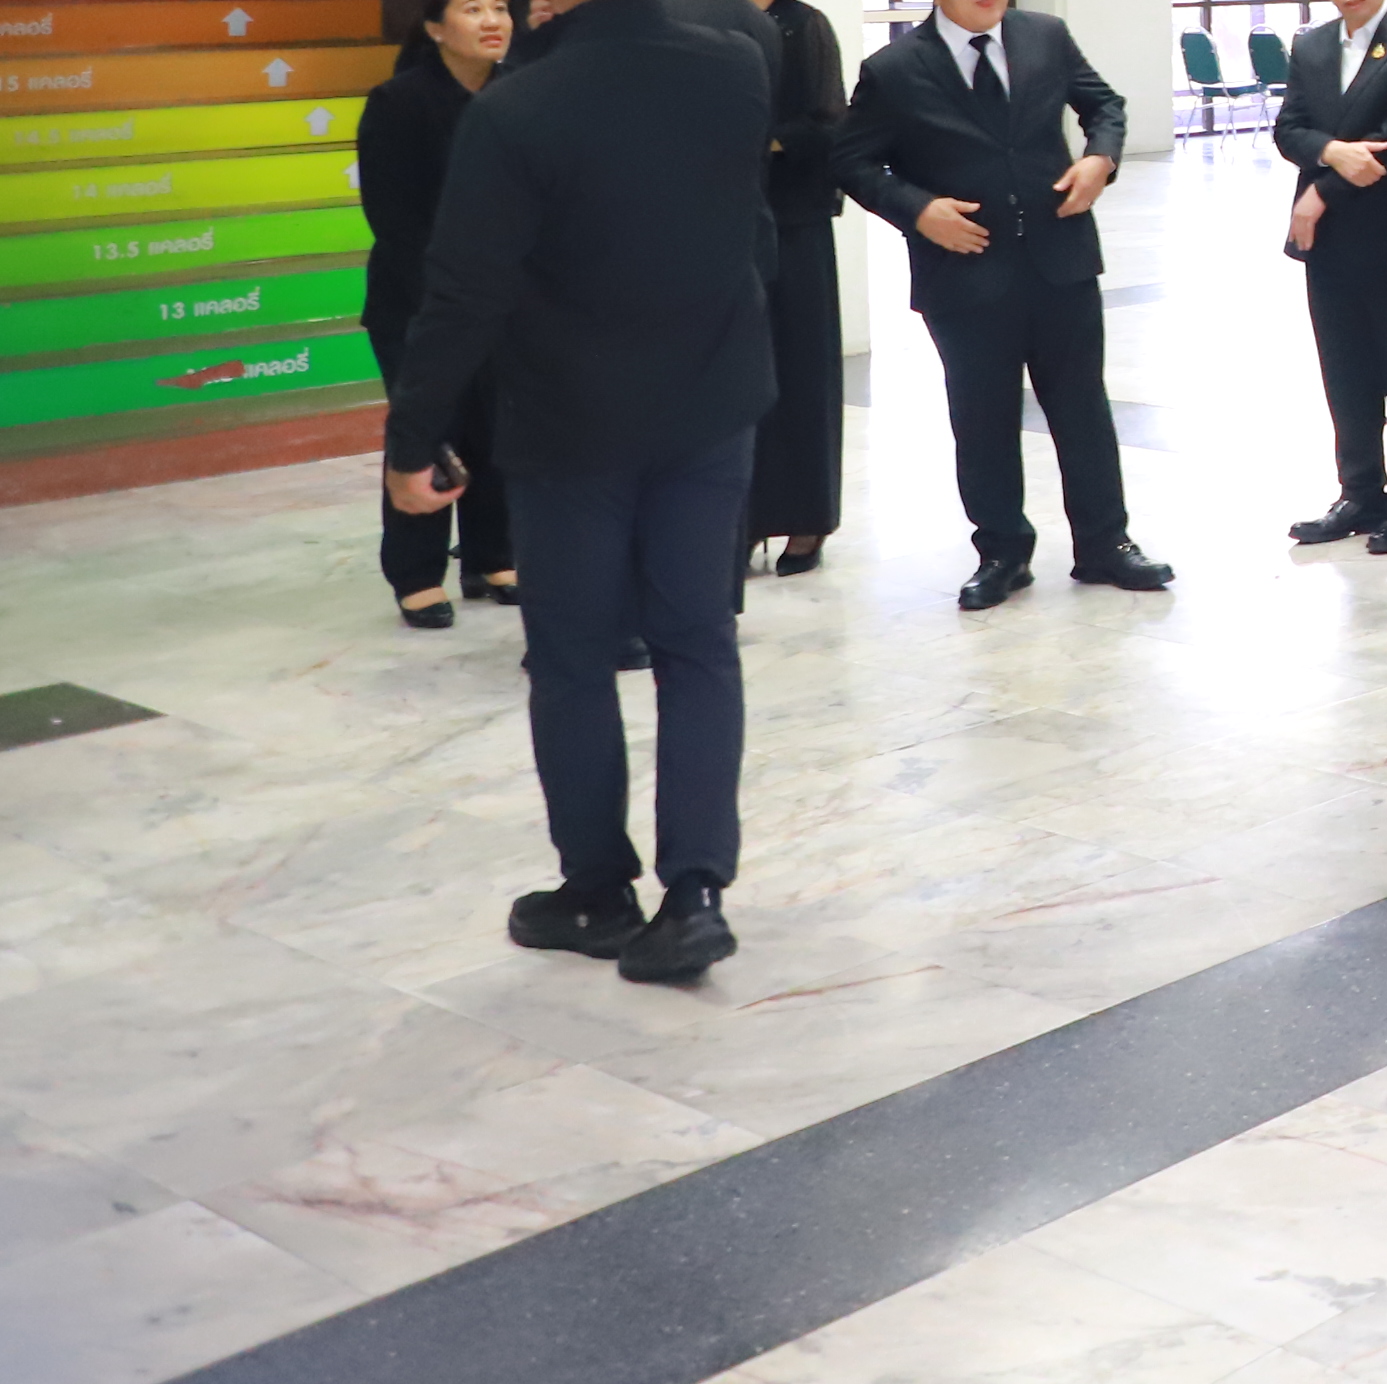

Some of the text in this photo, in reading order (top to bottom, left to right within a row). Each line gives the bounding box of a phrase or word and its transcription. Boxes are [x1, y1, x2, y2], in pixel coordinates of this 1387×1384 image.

[0, 12, 53, 36] คลอรี่
[72, 183, 98, 200] 14
[93, 226, 214, 260] 13.5 แคลอรี่
[160, 286, 260, 320] 13 แคลอรี่
[244, 347, 310, 379] แคลอรี่
